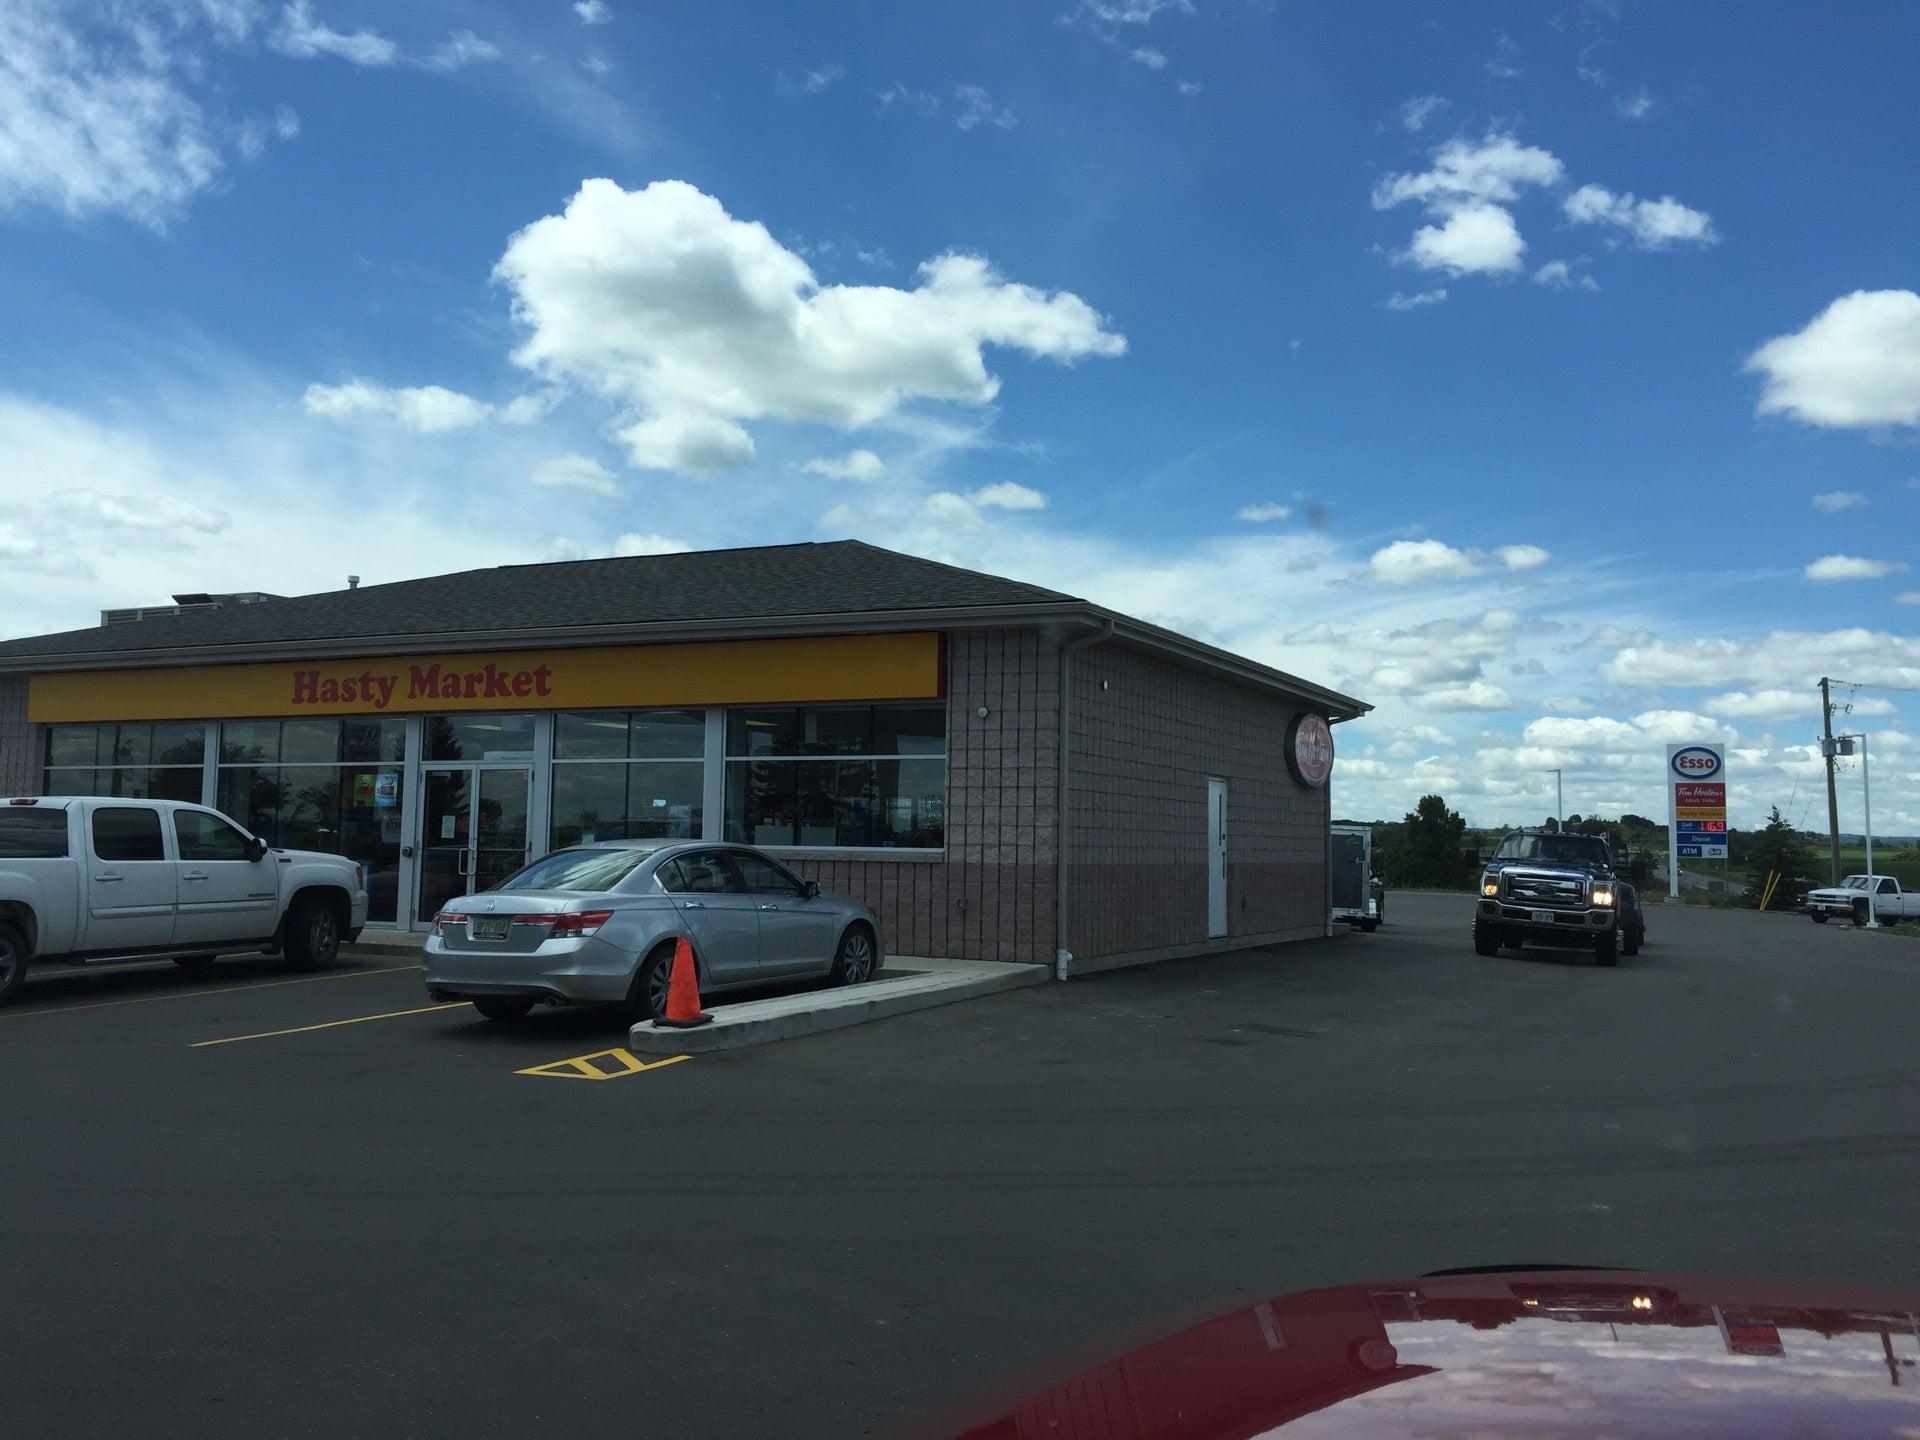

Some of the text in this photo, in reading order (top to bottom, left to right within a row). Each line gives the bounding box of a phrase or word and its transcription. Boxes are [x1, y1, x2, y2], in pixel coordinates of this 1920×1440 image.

[291, 662, 552, 708] Hasty Market
[1679, 756, 1714, 769] Esso
[1678, 787, 1723, 796] Tim Hortons
